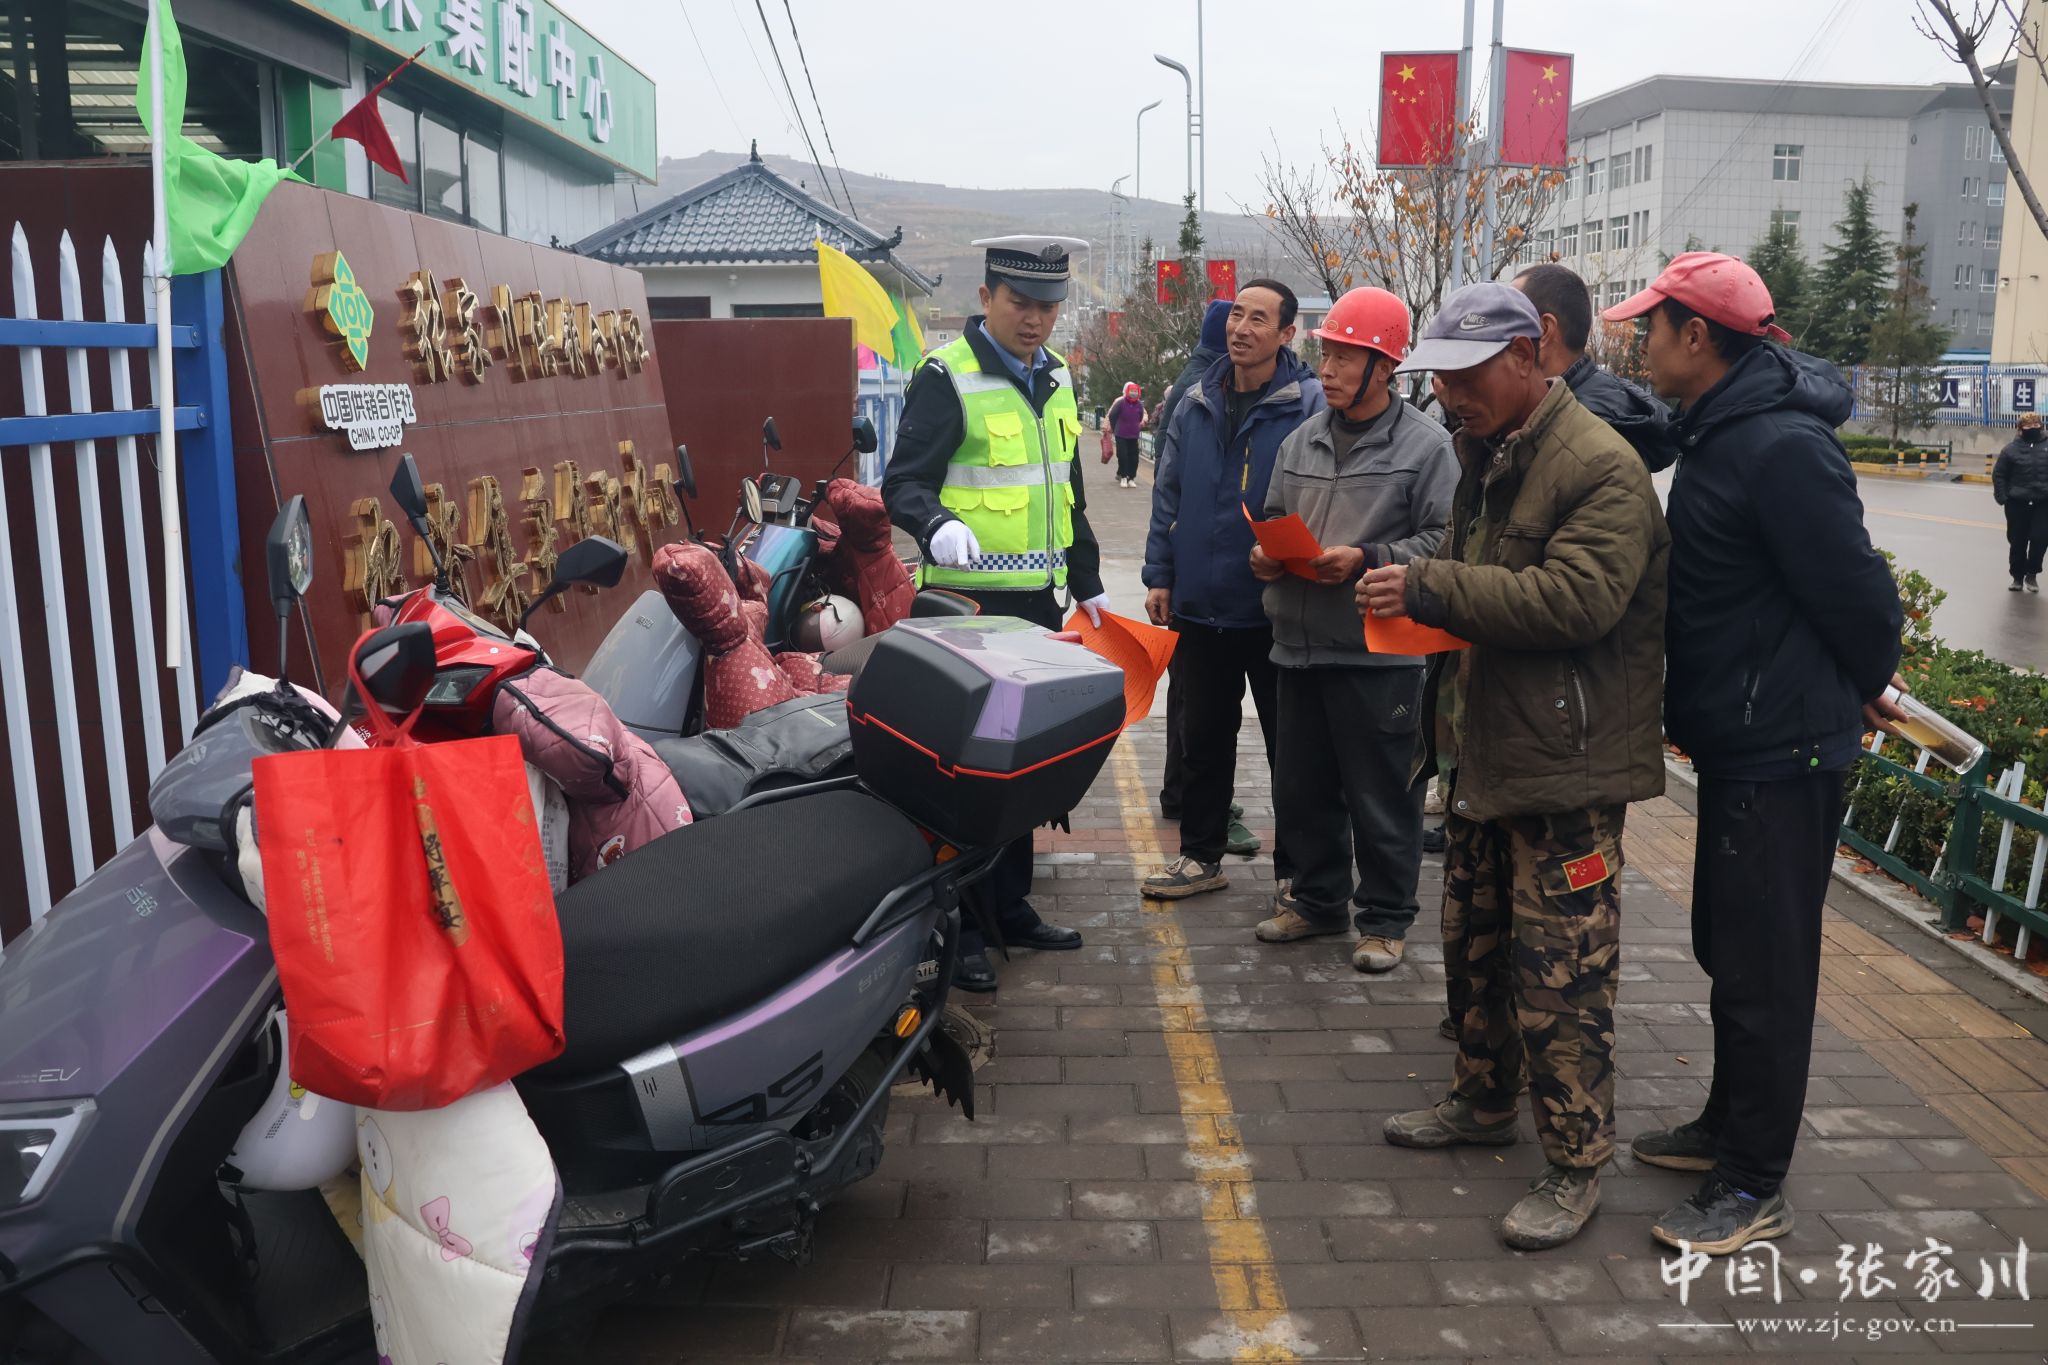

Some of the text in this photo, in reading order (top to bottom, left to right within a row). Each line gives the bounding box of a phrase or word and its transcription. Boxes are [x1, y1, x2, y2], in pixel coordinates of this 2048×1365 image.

[1943, 382, 1956, 404] 人
[2016, 382, 2032, 406] 生
[323, 389, 414, 423] 中国供销合作社
[351, 425, 400, 444] CHINA CO-OP
[916, 963, 940, 978] AILG
